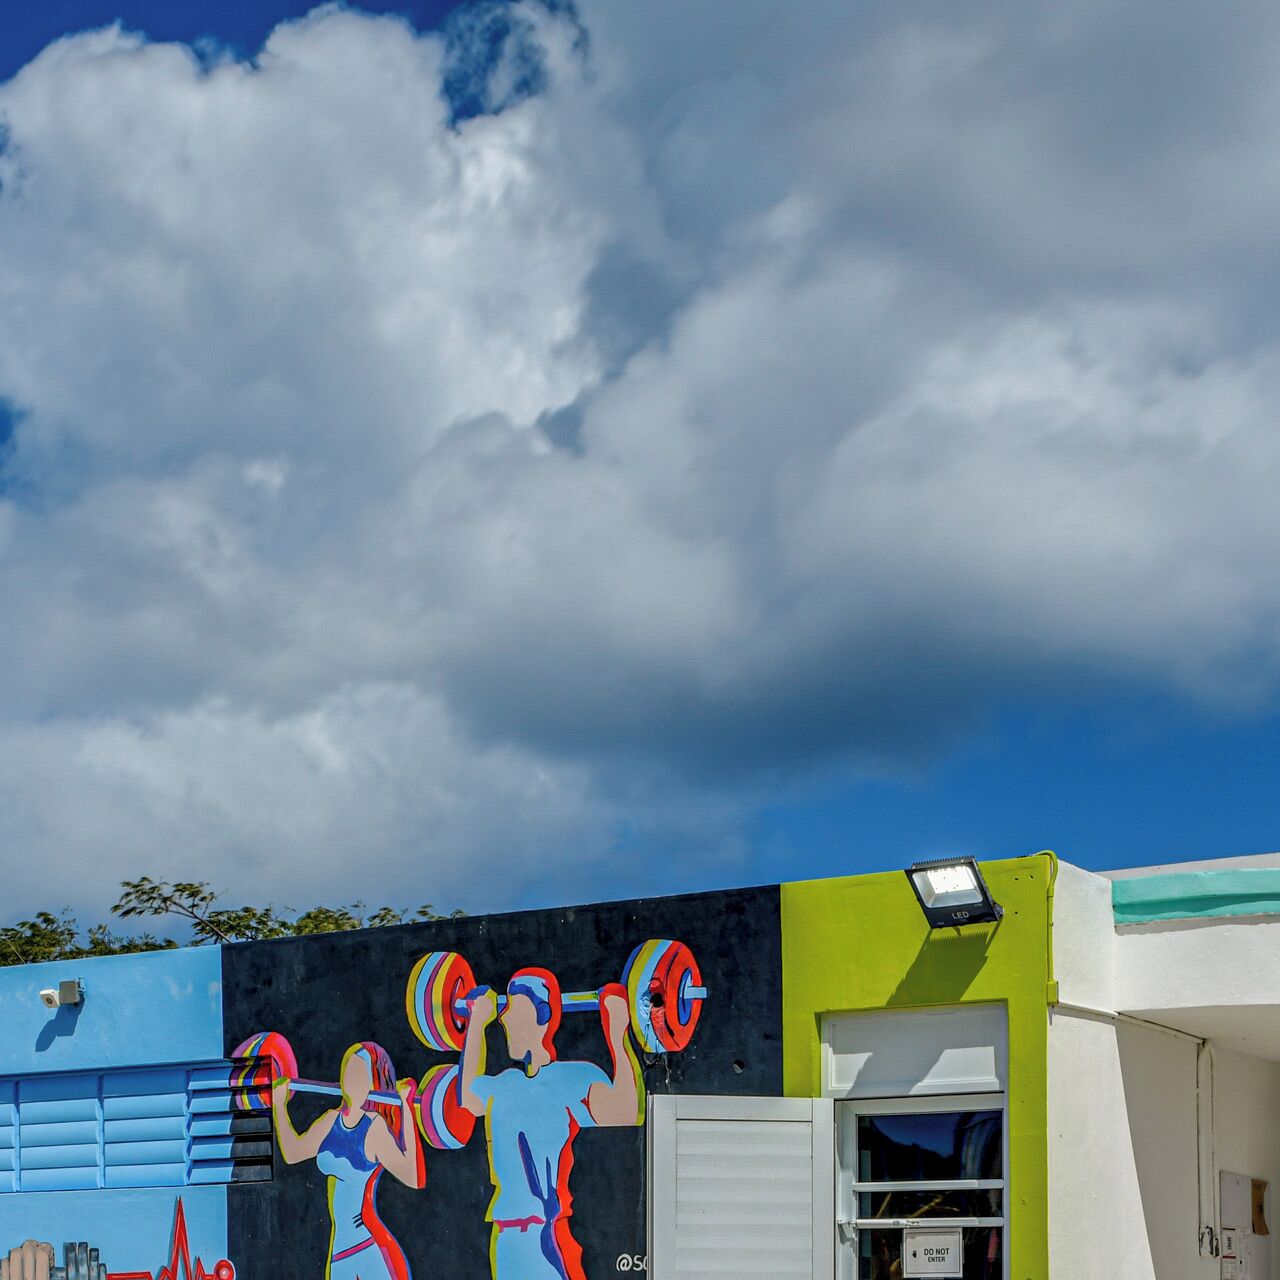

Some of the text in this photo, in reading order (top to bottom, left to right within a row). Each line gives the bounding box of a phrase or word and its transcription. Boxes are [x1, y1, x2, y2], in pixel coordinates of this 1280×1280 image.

[951, 911, 969, 920] LED
[923, 1248, 949, 1256] DO NOT
